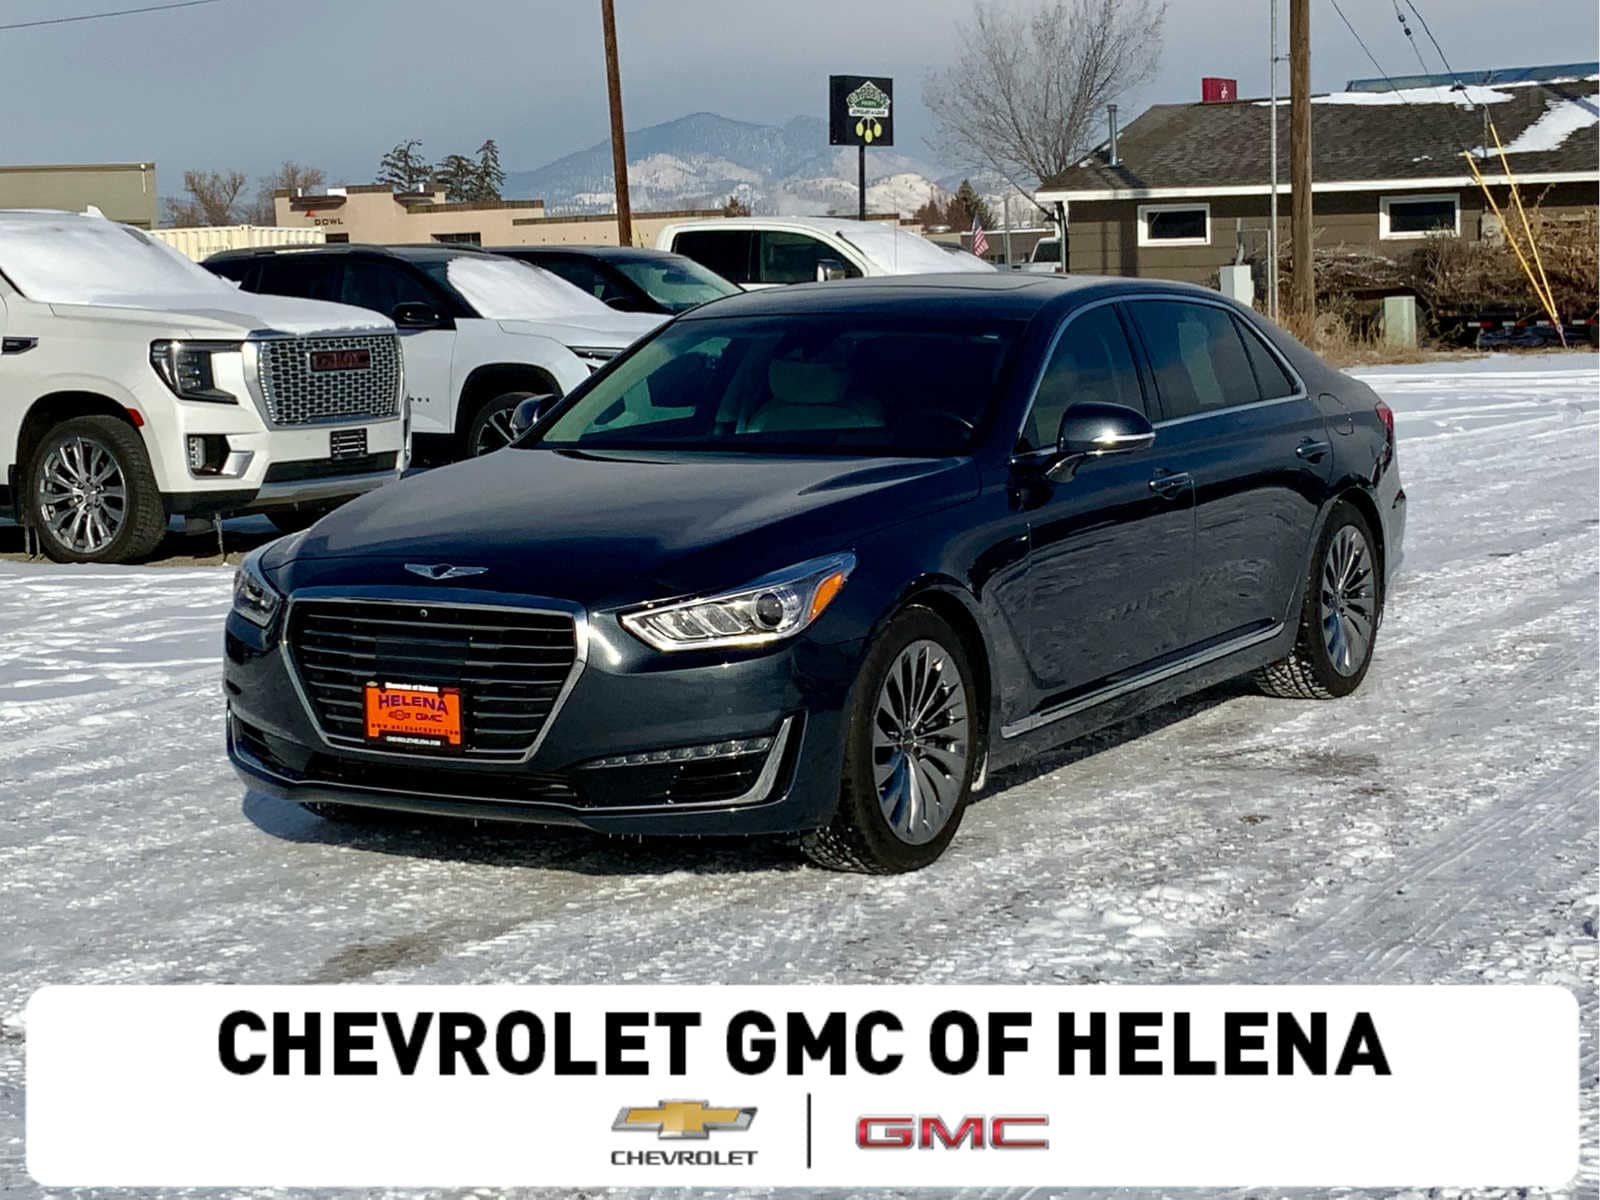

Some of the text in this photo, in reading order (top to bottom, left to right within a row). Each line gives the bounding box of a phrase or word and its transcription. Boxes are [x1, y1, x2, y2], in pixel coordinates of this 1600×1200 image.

[314, 217, 344, 226] DOWL
[378, 695, 448, 715] HELENA
[415, 712, 444, 723] GMC
